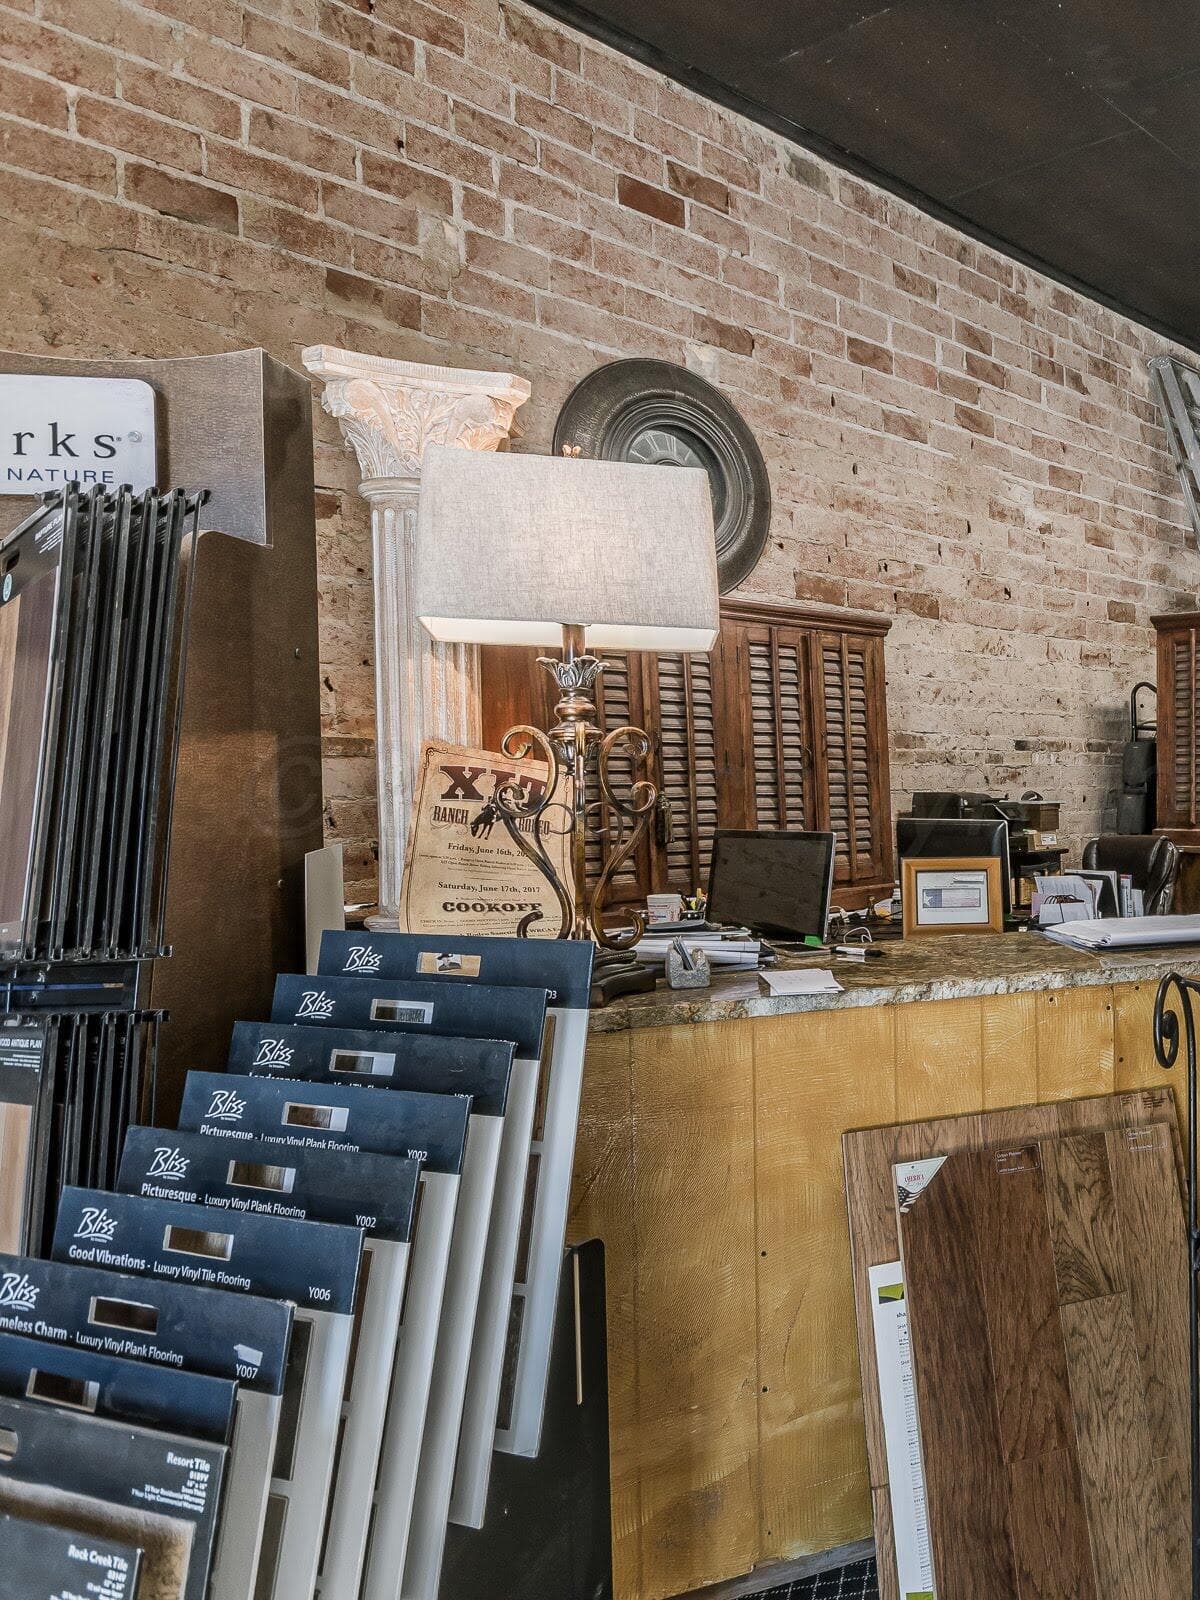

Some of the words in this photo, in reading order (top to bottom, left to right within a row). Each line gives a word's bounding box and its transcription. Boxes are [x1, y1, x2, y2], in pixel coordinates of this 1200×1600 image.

[7, 467, 115, 484] NATURE
[433, 805, 470, 824] RANCH
[447, 843, 475, 853] Friday,
[475, 845, 494, 854] June
[496, 848, 514, 857] 16th,
[438, 881, 478, 892] Saturday,
[478, 884, 498, 893] June
[501, 885, 521, 893] 17th,
[442, 901, 543, 913] COOKOFF
[342, 945, 383, 971] Bliss
[295, 991, 336, 1017] Bliss
[252, 1039, 295, 1067] Bliss
[204, 1090, 248, 1119] Bliss
[200, 1124, 254, 1141] Picturesque
[286, 1135, 306, 1146] Vinyl
[305, 1138, 327, 1150] Plank
[327, 1140, 360, 1153] Flooring
[146, 1147, 190, 1178] Bliss
[407, 1149, 428, 1162] Y002
[141, 1182, 197, 1203] Picturesque
[204, 1194, 231, 1210] Luxury
[231, 1197, 250, 1211] Vinyl
[250, 1200, 272, 1214] Plank
[273, 1203, 306, 1219] Flooring
[73, 1207, 119, 1240] Bliss
[355, 1214, 377, 1228] Y002
[69, 1244, 95, 1262] Good
[95, 1247, 146, 1270] Vibrations
[153, 1261, 181, 1279] Luxury
[181, 1265, 201, 1282] Vinyl
[201, 1268, 216, 1281] Tile
[216, 1271, 251, 1290] Flooring
[0, 1272, 41, 1309] Bliss
[308, 1286, 331, 1301] Y006
[34, 1320, 67, 1340] Charm
[76, 1331, 104, 1349] Luxury
[104, 1336, 124, 1353] Vinyl
[124, 1340, 147, 1357] Plank
[148, 1345, 183, 1366] Flooring
[235, 1363, 259, 1379] Y007
[167, 1451, 194, 1469] Resort
[194, 1457, 211, 1472] Tile
[68, 1544, 88, 1561] Rock
[89, 1550, 112, 1568] Creek
[112, 1556, 128, 1572] Tile
